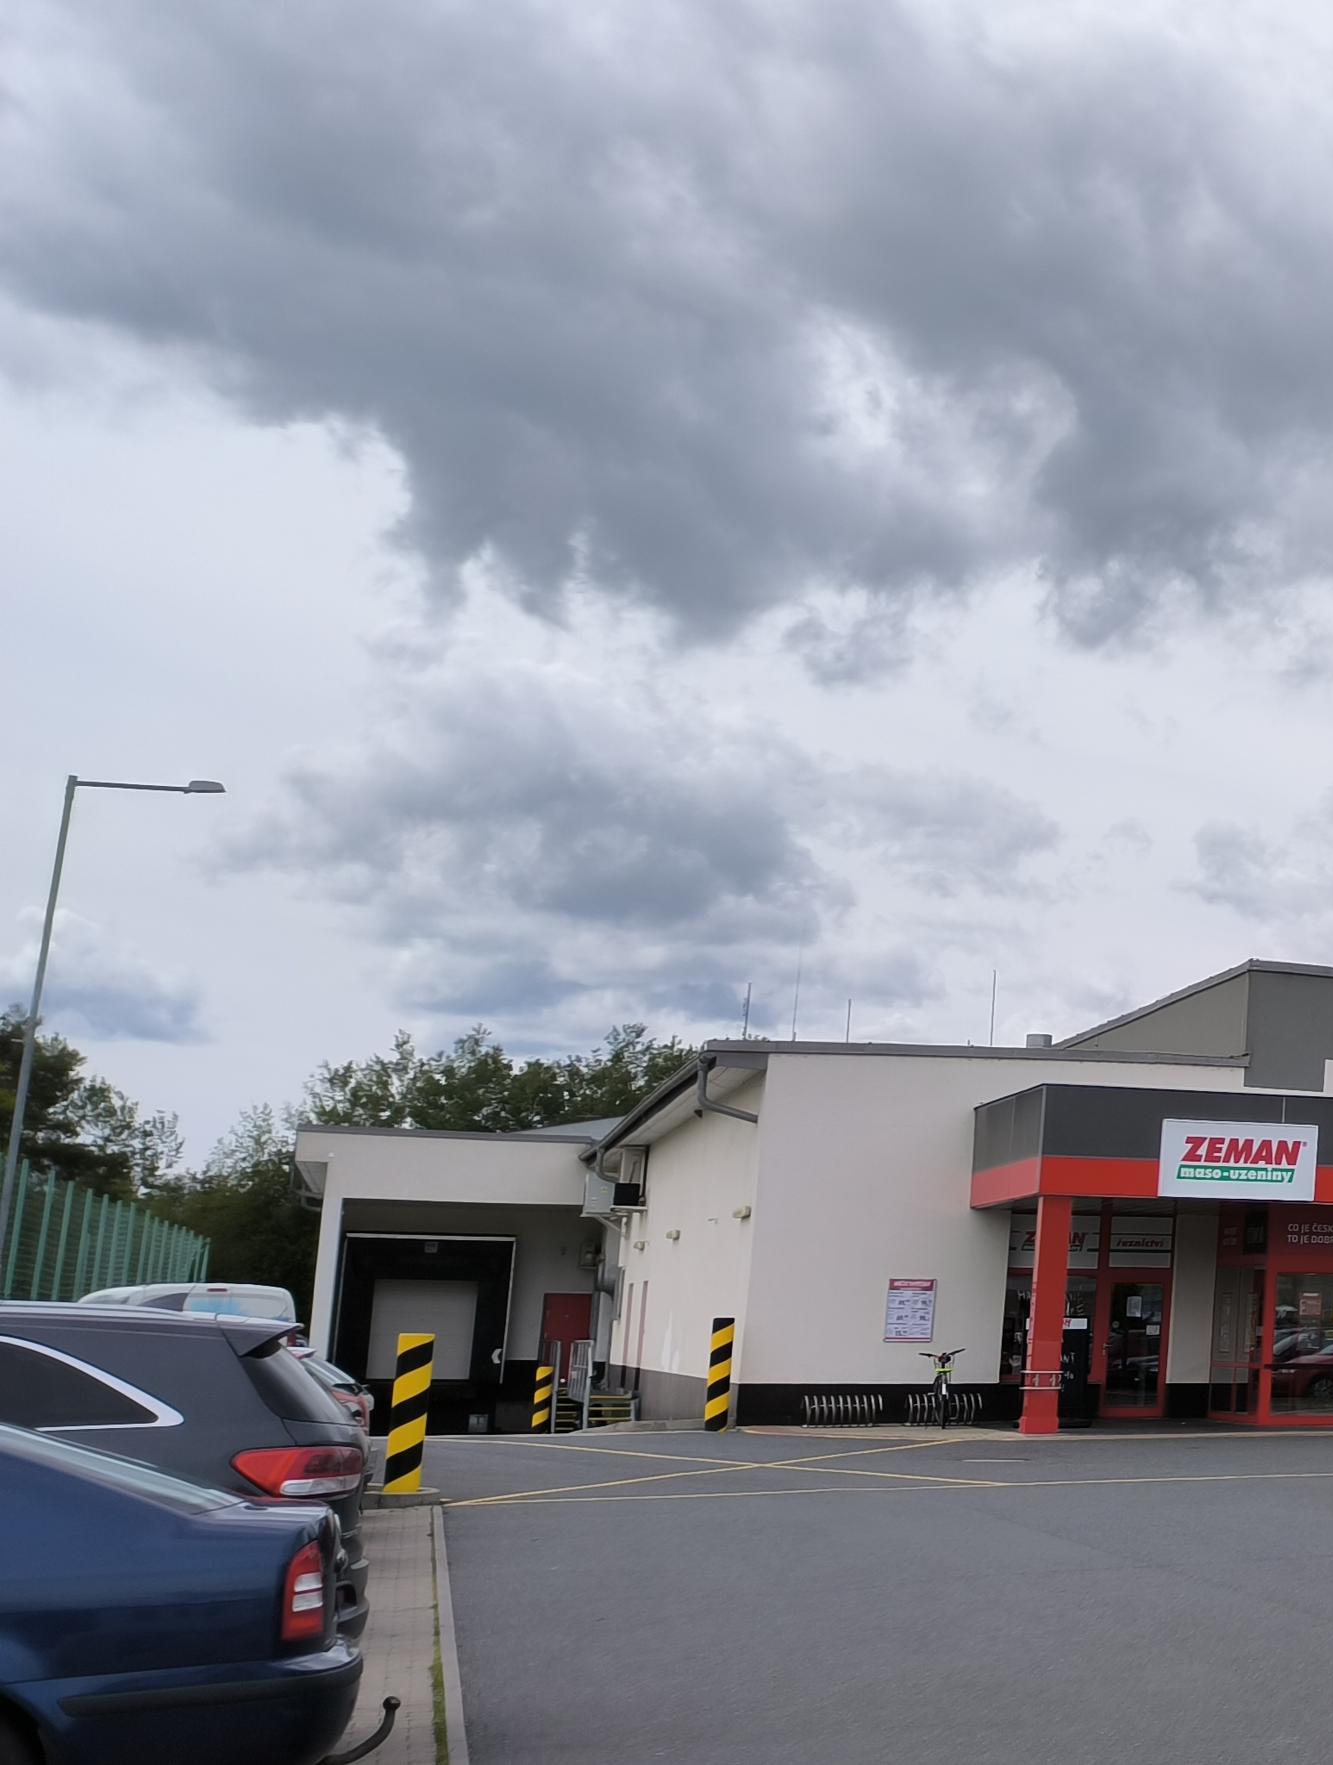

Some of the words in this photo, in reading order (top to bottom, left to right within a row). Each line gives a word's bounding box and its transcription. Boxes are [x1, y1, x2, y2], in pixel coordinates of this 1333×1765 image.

[1181, 1136, 1301, 1166] ZEMAN
[1288, 1223, 1299, 1232] CO
[1301, 1224, 1310, 1233] JE
[1287, 1234, 1299, 1243] TO
[1300, 1235, 1310, 1245] JE
